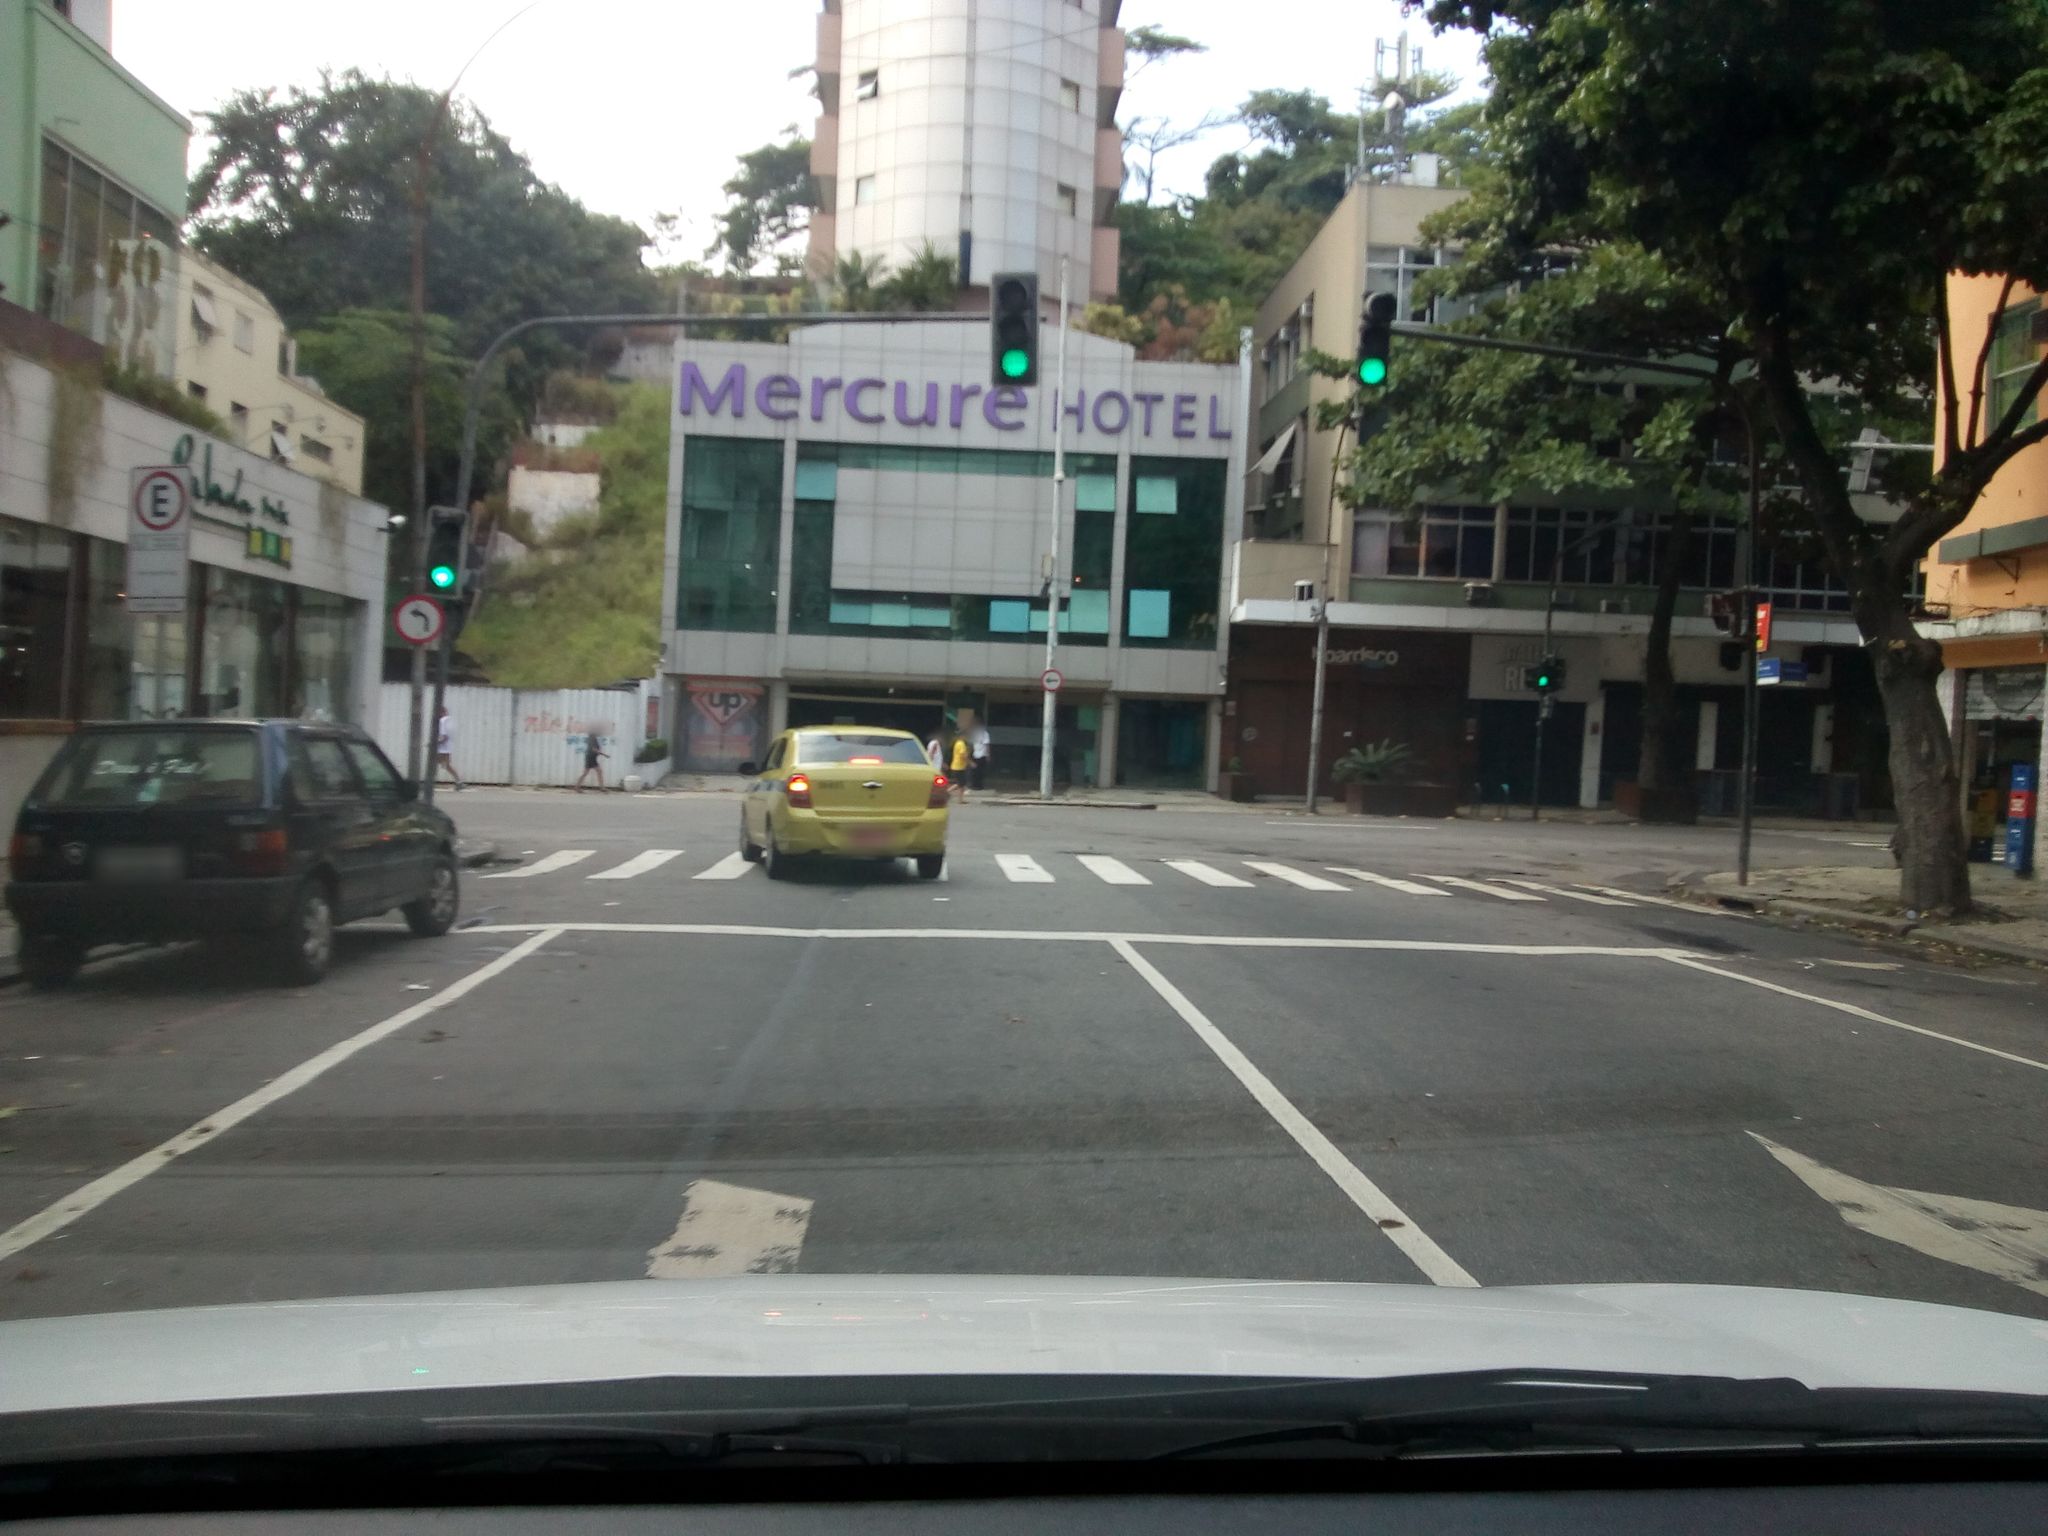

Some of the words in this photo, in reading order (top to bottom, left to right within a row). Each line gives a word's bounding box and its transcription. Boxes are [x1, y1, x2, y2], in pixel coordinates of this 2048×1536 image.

[679, 361, 1029, 432] Mercure
[1052, 388, 1233, 439] HOTEL
[152, 484, 168, 518] E
[709, 692, 742, 717] up
